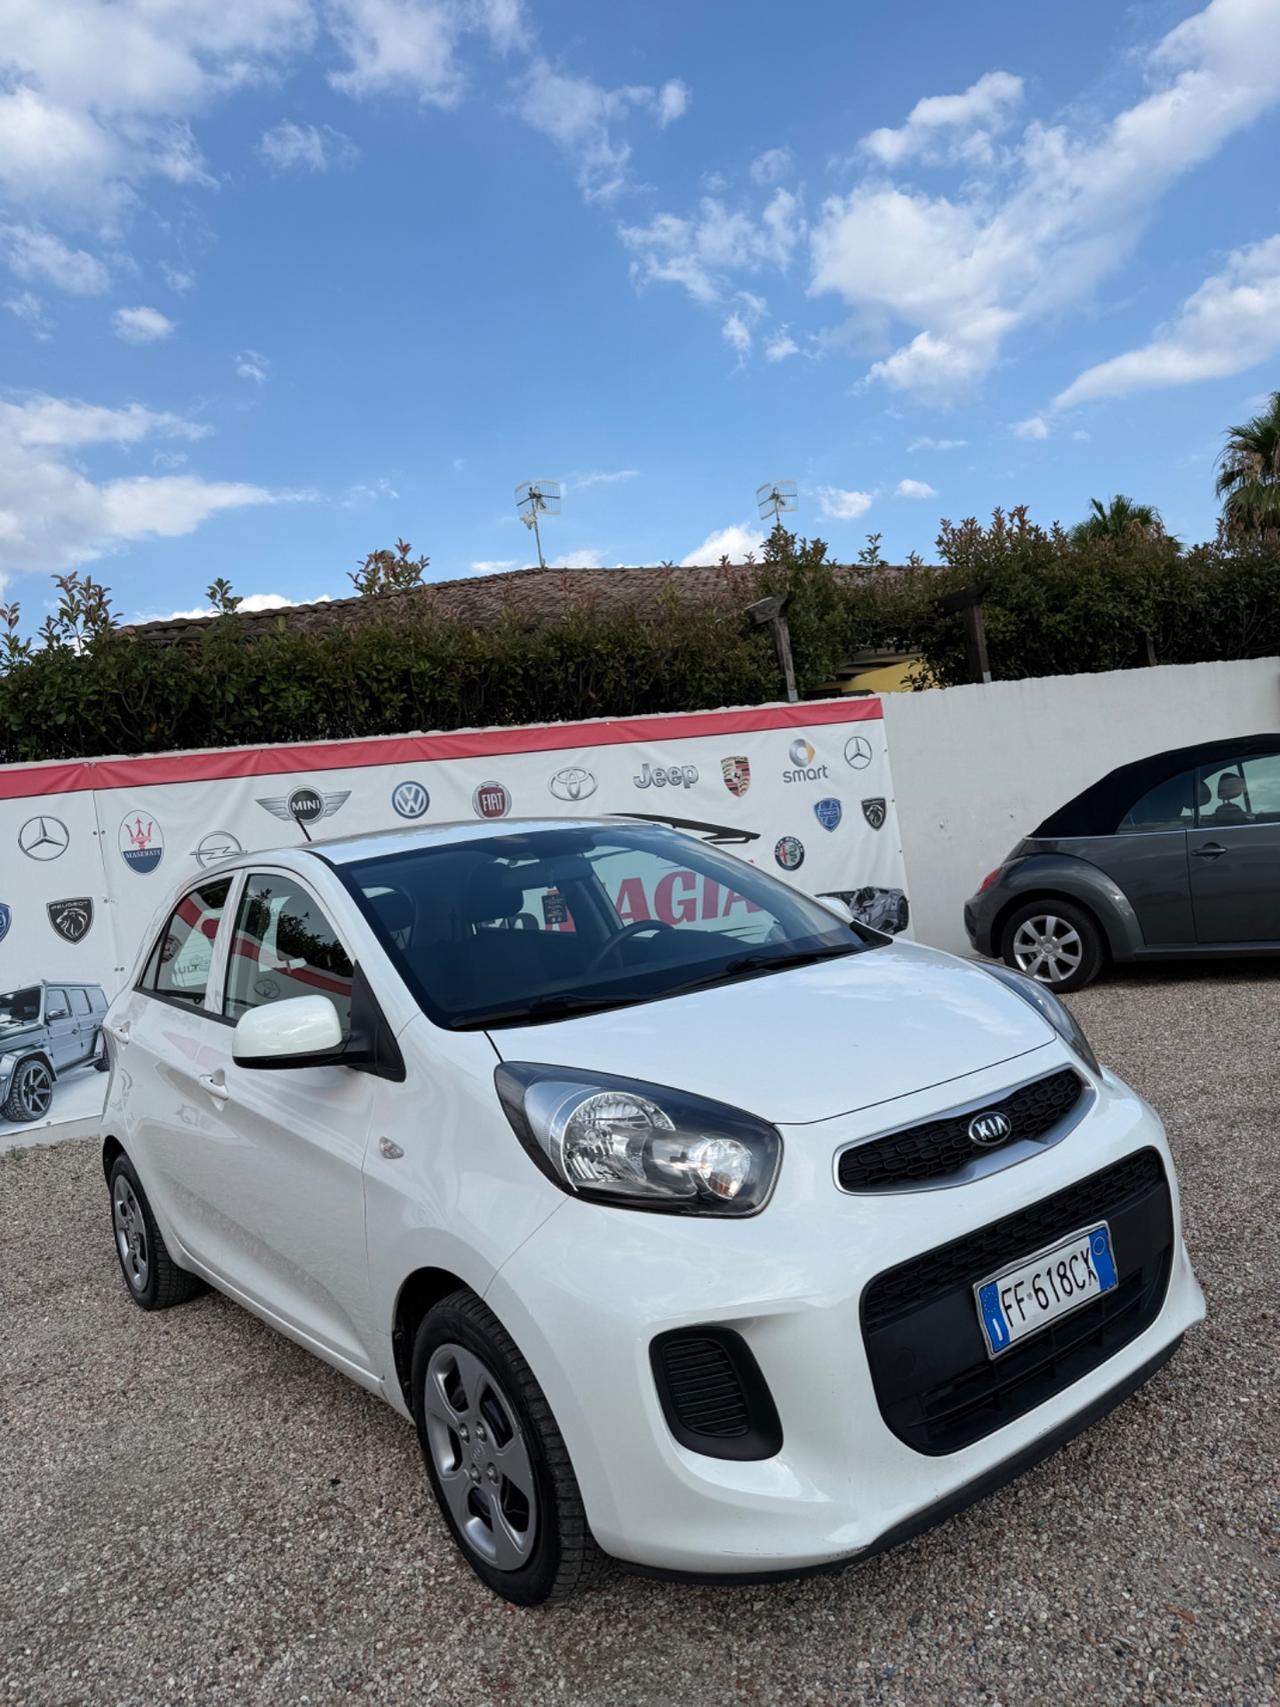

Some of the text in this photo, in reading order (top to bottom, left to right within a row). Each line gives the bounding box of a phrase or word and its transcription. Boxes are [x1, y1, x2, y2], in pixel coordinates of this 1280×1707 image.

[633, 763, 699, 789] Jeep
[783, 765, 828, 783] smart
[291, 799, 321, 812] MINI
[482, 791, 504, 812] FIAT
[974, 1115, 1009, 1141] KIA
